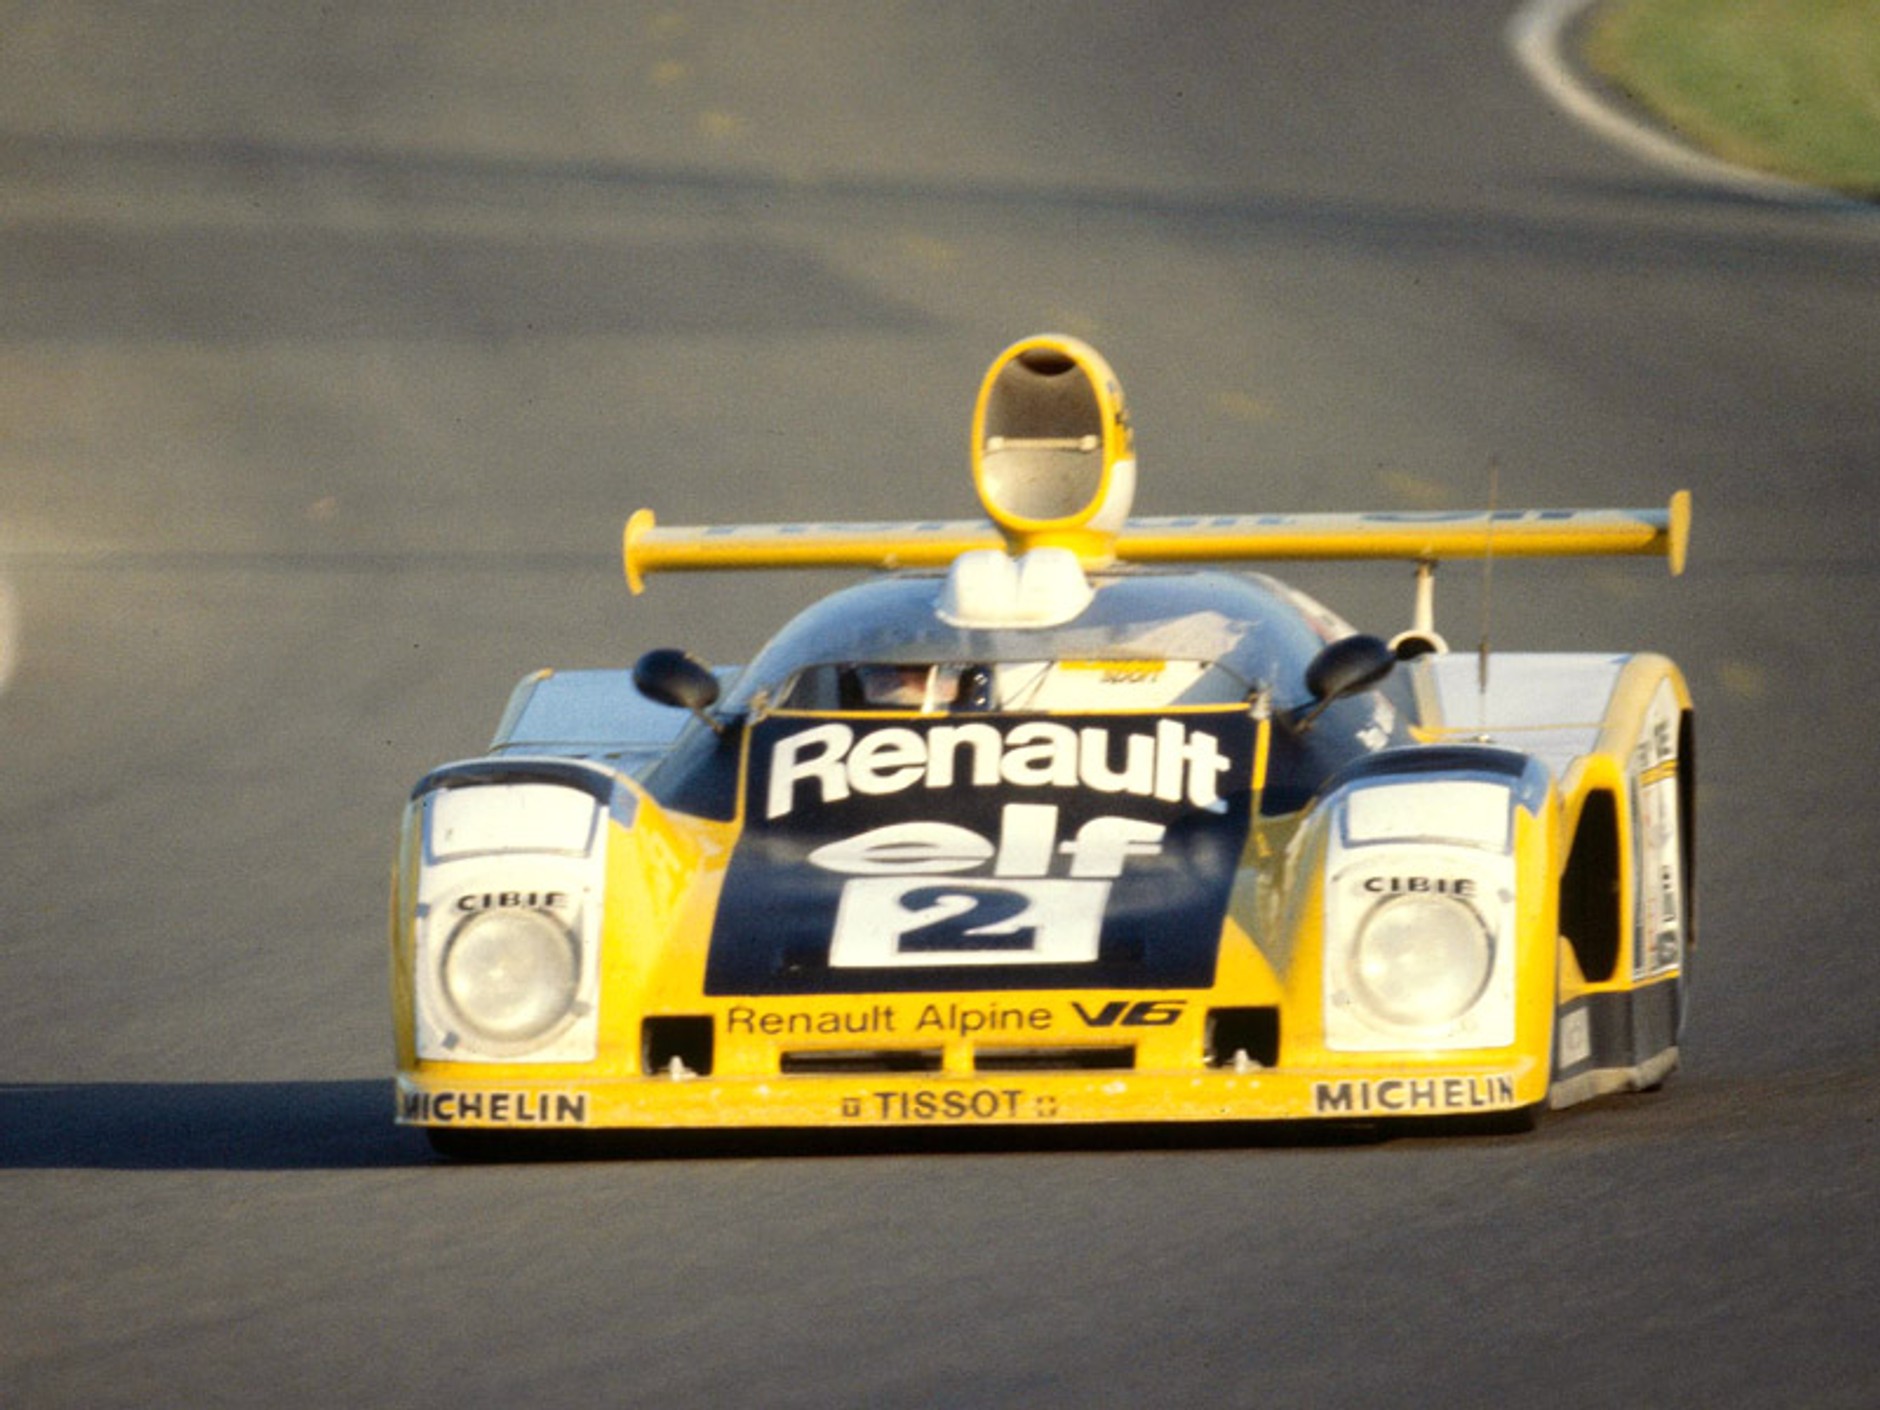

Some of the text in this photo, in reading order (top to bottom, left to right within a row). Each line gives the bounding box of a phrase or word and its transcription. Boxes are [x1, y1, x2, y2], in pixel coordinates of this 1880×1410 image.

[768, 719, 1230, 819] Renault
[808, 804, 1165, 877] elf
[457, 892, 566, 911] CIBIE
[1363, 875, 1478, 898] CIBIE
[896, 886, 1035, 952] 2
[726, 1000, 1188, 1037] Renault Alpine V6
[402, 1091, 587, 1122] MICHELIN
[873, 1089, 1023, 1119] TISSOT
[1315, 1077, 1516, 1112] MICHELIN
